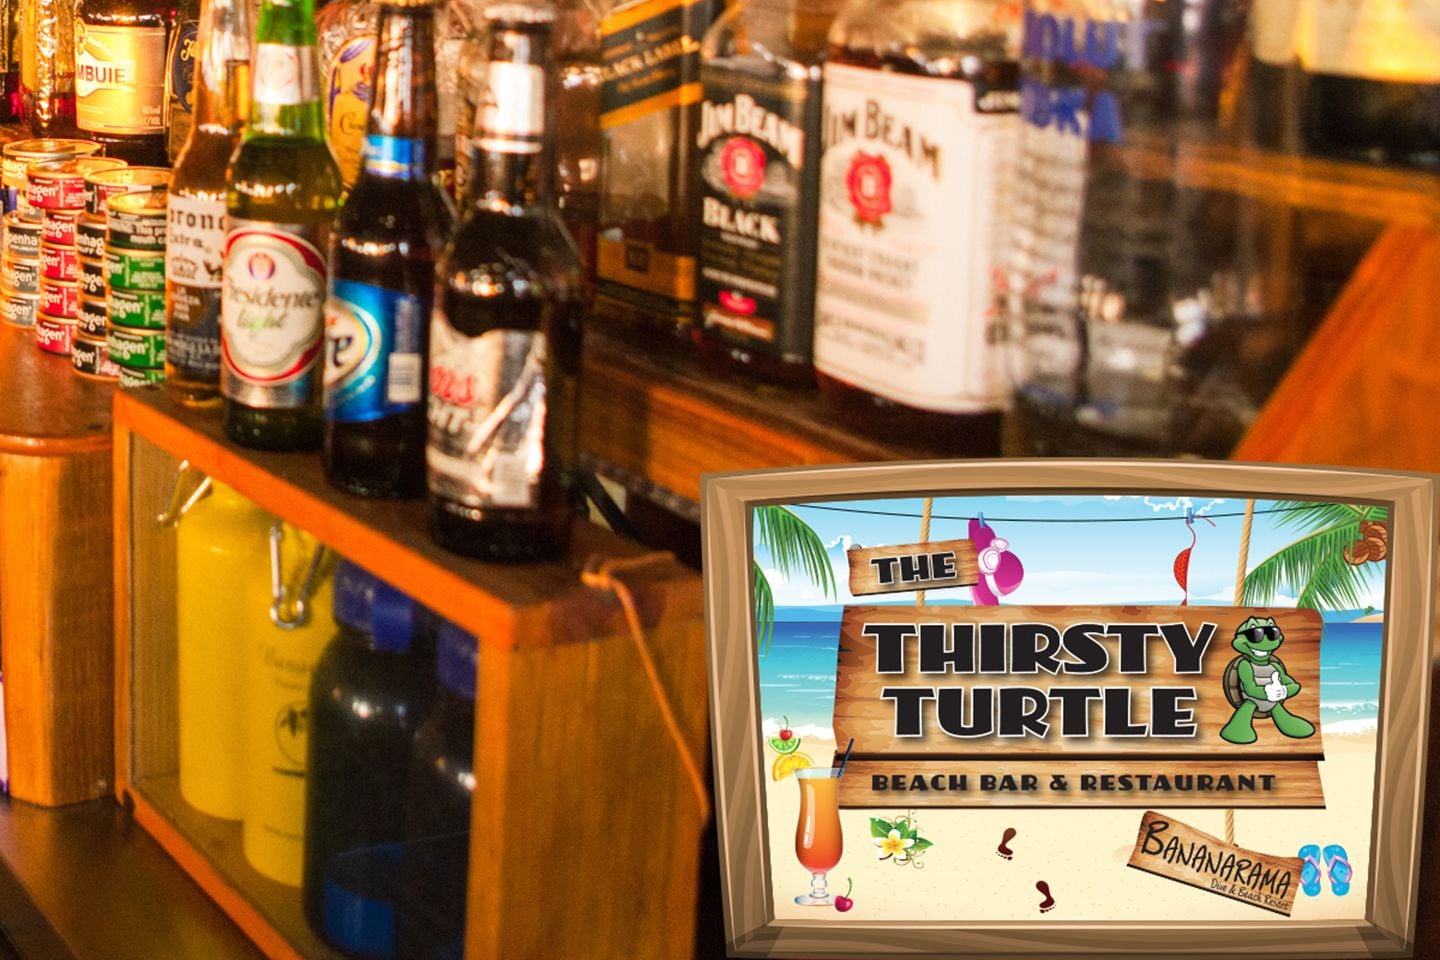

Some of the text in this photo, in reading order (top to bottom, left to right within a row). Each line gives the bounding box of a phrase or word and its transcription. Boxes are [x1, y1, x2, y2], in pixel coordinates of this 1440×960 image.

[697, 92, 805, 171] JIM BEAM
[864, 97, 945, 184] BEAM
[702, 195, 781, 244] BLACK
